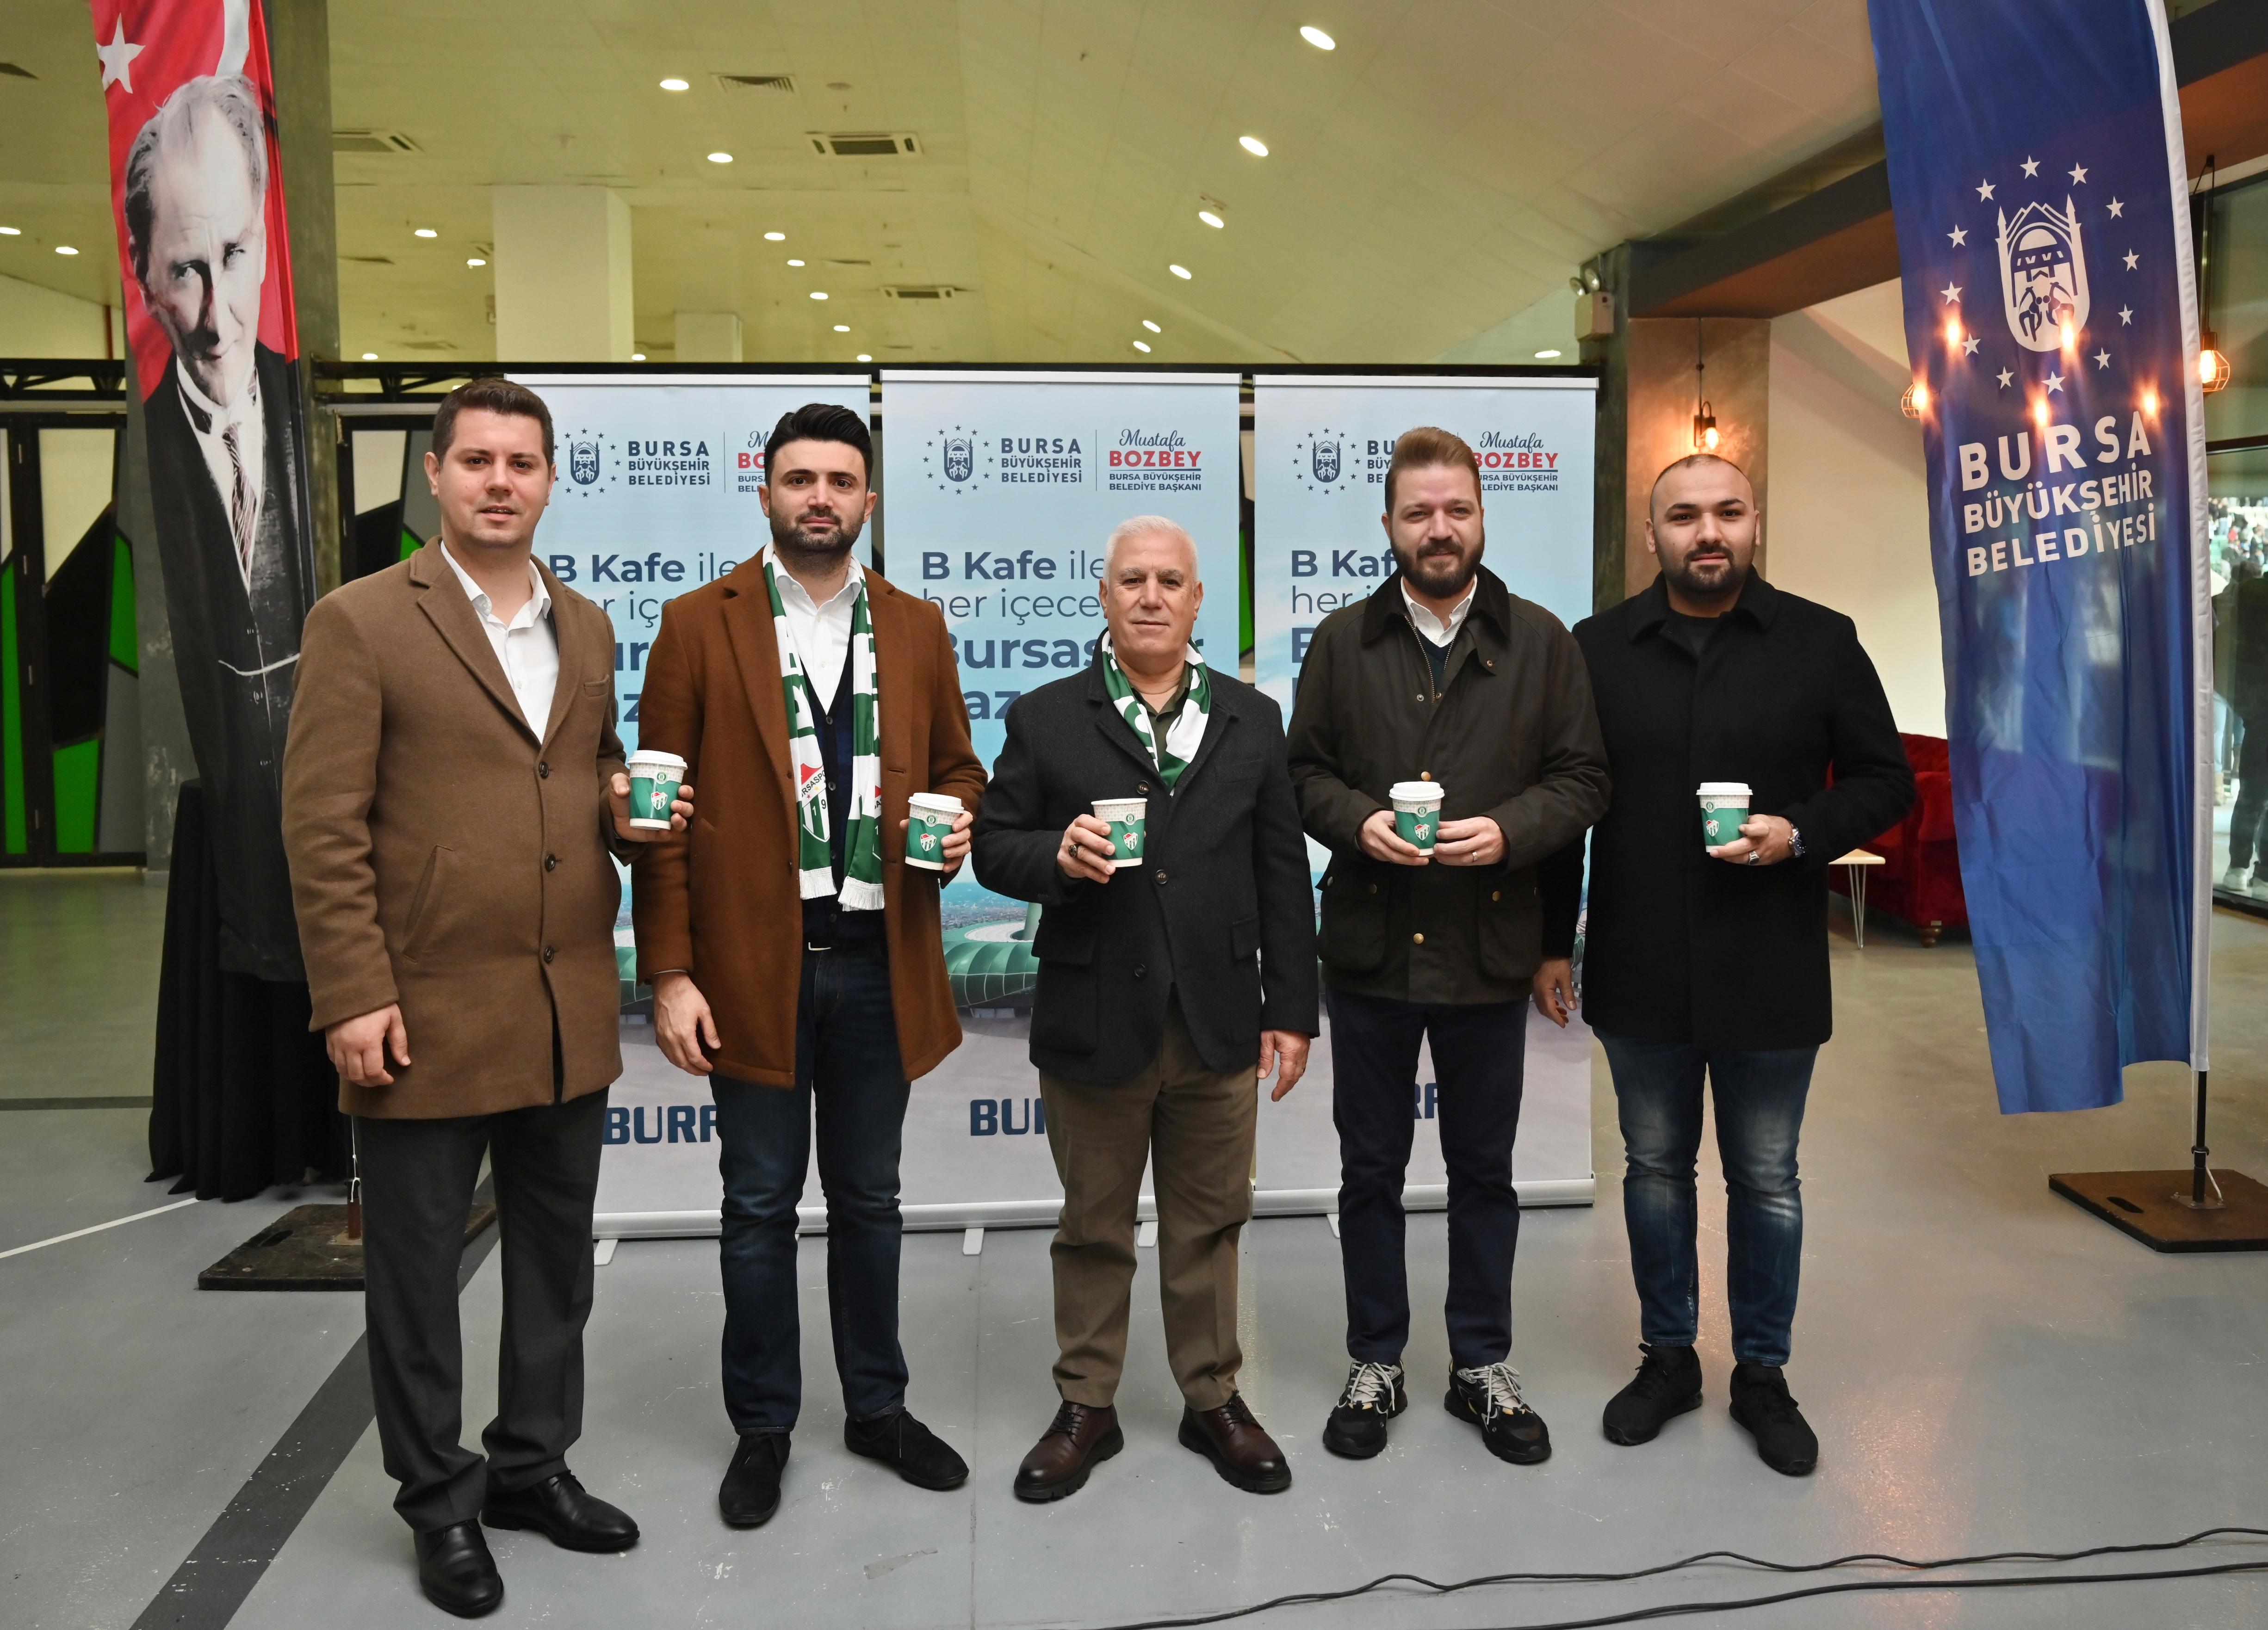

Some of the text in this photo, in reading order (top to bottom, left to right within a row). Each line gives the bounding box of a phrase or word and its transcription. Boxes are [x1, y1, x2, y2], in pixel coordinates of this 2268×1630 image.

[1001, 438, 1081, 454] BURSA
[1119, 429, 1186, 452] Mustafa
[1480, 431, 1544, 453] Mustafa
[628, 441, 709, 457] BURSA
[1959, 411, 2152, 491] BURSA
[629, 457, 709, 473] BÜYÜKŞEHİR
[1001, 455, 1081, 470] BÜYÜKŞEHİR
[1109, 450, 1202, 467] BOZBEY
[629, 472, 710, 485] BELEDİYESİ
[1002, 469, 1082, 483] BELEDİYESİ
[1143, 471, 1201, 482] BÜYÜKŞEHİR
[1368, 474, 1387, 483] BE
[1502, 472, 1558, 482] BÜYÜKŞEHİR
[1109, 481, 1202, 492] BELEDİYE BAŞKANI
[1481, 482, 1558, 493] LEDİYE BAŞKANI
[1964, 462, 2153, 534] BÜYÜKŞEHİR
[1967, 503, 2156, 577] BELEDİYESİ
[549, 555, 577, 582] B
[592, 552, 685, 582] Kafe
[923, 550, 1104, 580] B Kafe ile
[1291, 550, 1318, 577] B
[923, 588, 987, 617] her
[1292, 585, 1353, 613] her
